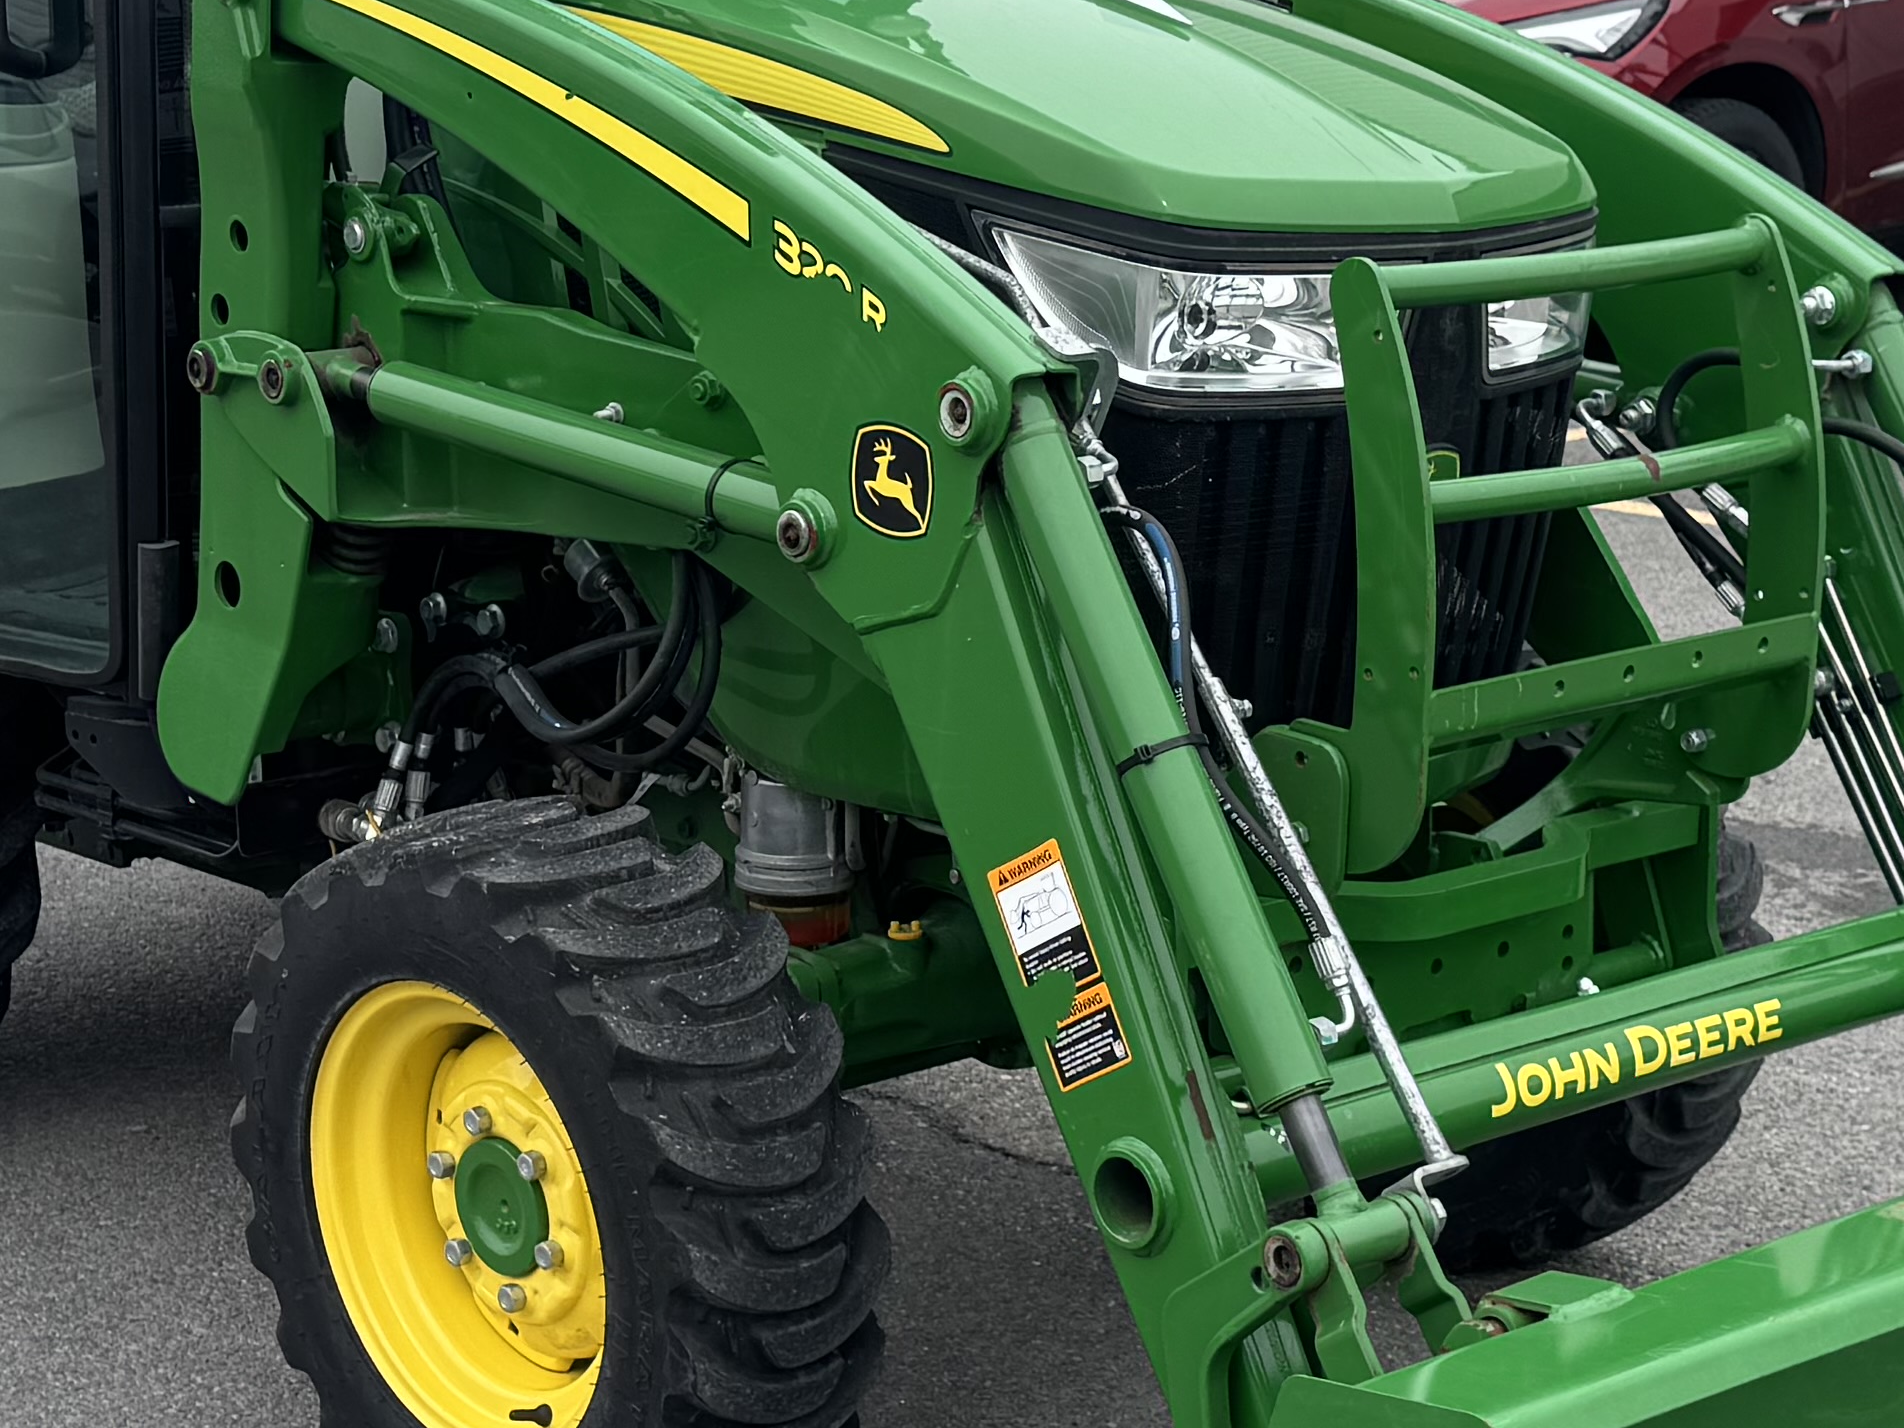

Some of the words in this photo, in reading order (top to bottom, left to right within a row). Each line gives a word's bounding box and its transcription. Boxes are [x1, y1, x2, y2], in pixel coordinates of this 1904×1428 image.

[1008, 848, 1053, 880] WARNING
[1491, 1042, 1621, 1118] JOHN
[1624, 998, 1784, 1078] DEERE
